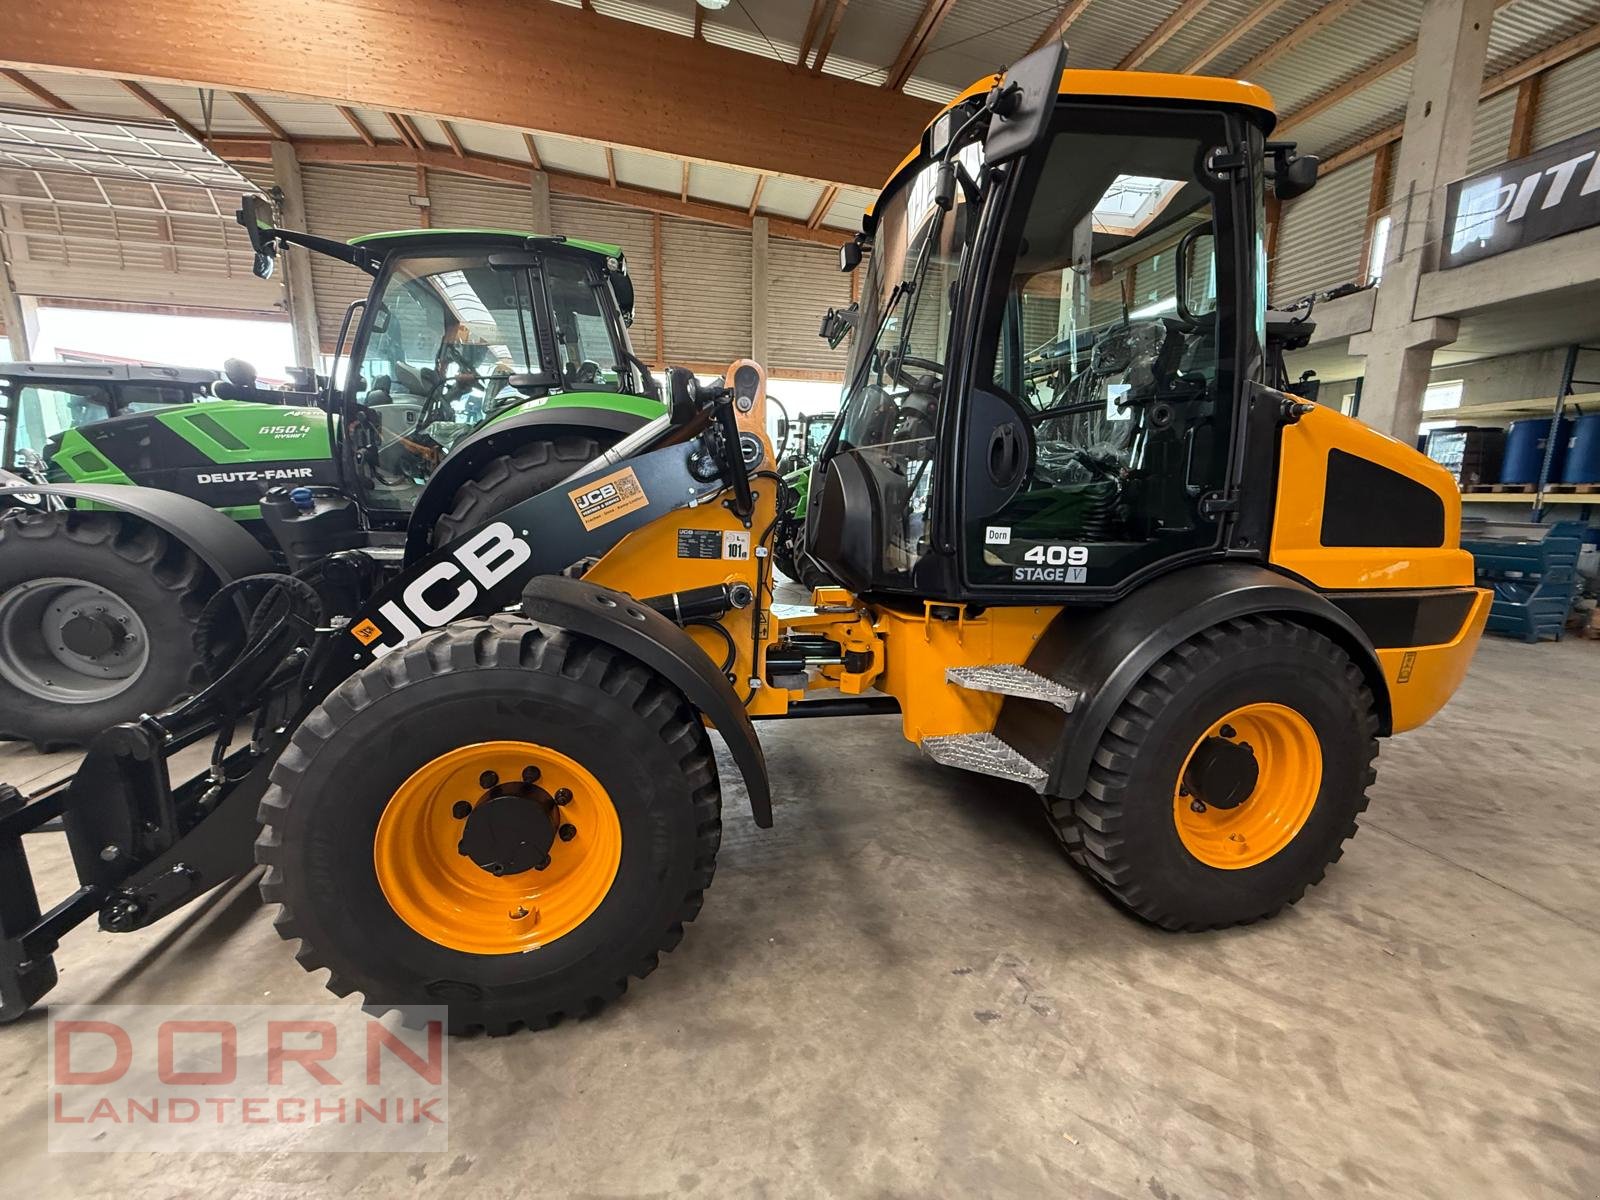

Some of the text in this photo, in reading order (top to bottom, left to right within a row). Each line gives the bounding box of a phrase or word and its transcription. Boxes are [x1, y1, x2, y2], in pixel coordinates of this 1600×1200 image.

[258, 425, 310, 434] 6150.4
[196, 468, 313, 484] DEUTZ-FAHR
[578, 484, 617, 509] JCB
[989, 530, 1008, 540] Dorn
[728, 543, 742, 557] 101
[1024, 545, 1089, 566] 409
[1015, 568, 1065, 581] STAGE
[371, 522, 531, 659] JCB
